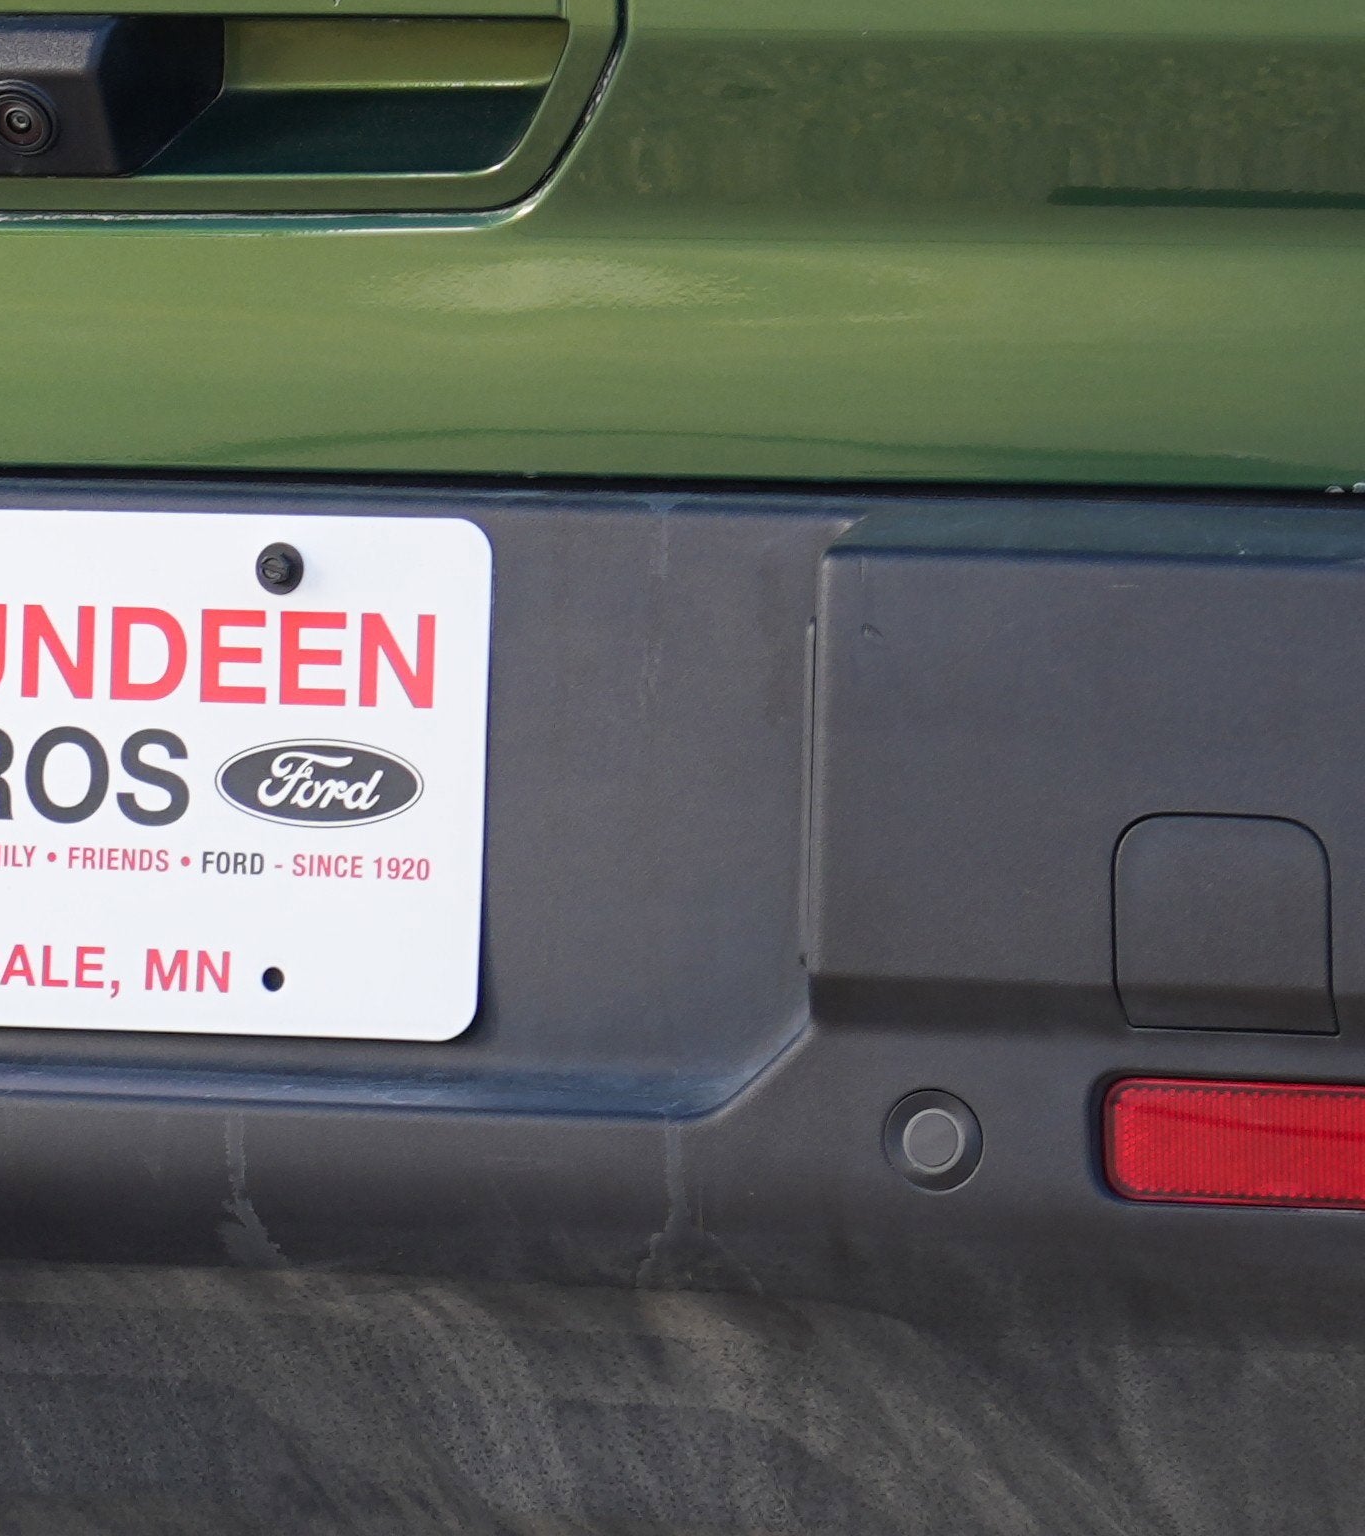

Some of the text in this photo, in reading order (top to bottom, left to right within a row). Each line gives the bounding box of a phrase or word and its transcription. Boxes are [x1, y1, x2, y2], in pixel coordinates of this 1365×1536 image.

[256, 751, 382, 811] Ford
[67, 846, 170, 872] FRIENDS
[200, 851, 265, 875] FORD
[292, 854, 363, 878] SINCE
[372, 858, 431, 881] 1920
[144, 949, 232, 993] MN
